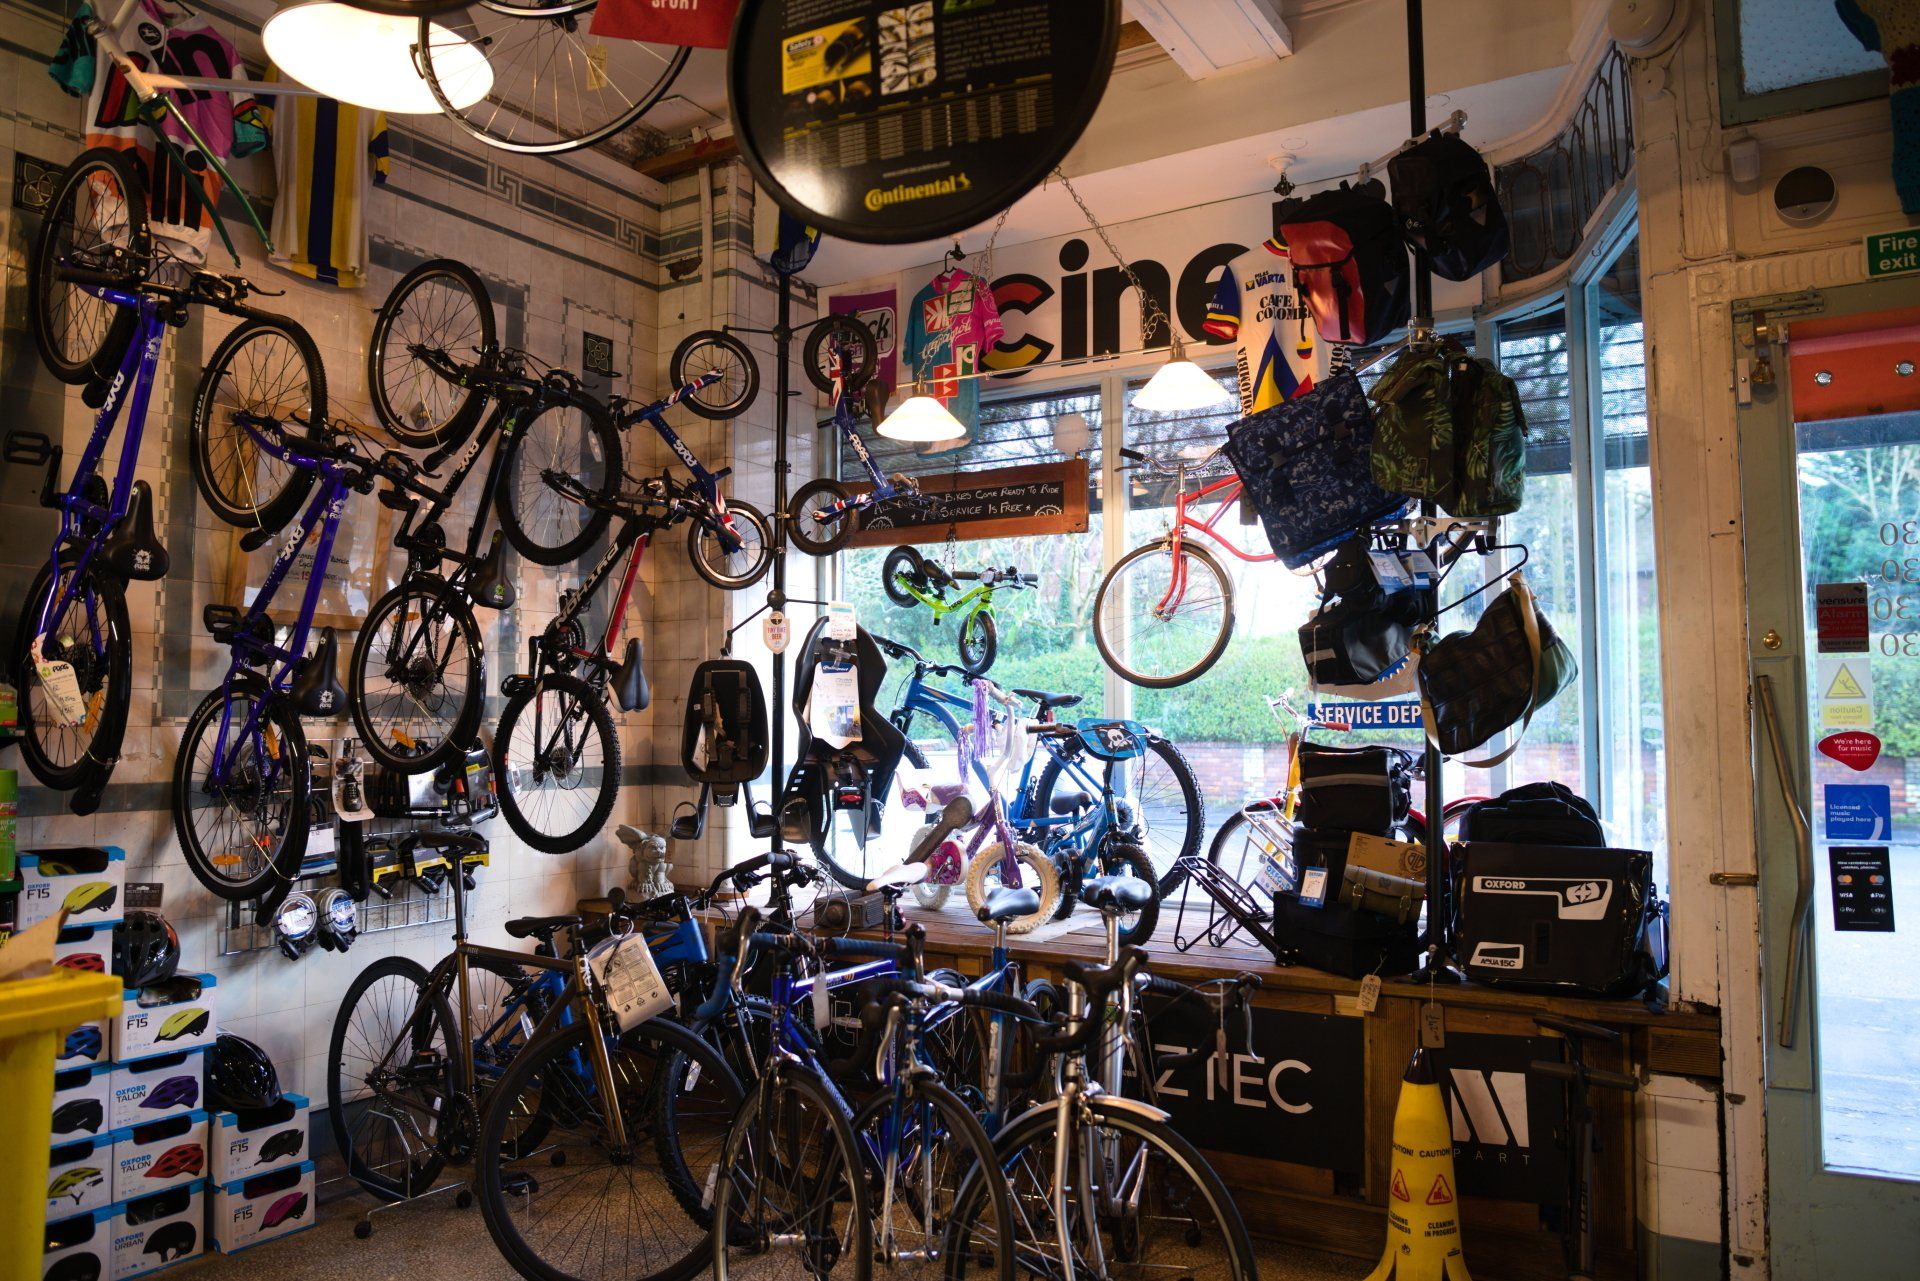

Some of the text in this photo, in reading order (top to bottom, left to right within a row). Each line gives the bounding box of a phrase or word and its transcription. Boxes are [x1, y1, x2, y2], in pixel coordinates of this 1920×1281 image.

[864, 175, 957, 211] Continental
[1879, 237, 1918, 253] Fire
[1879, 252, 1917, 270] exit
[1255, 272, 1286, 287] VARTA
[1259, 294, 1293, 308] CAFE
[673, 439, 698, 467] FROG
[555, 541, 619, 630] PYTHON
[1314, 704, 1422, 724] SERVICE DEP
[1484, 880, 1526, 890] OXFORD
[26, 888, 51, 900] F15
[126, 1019, 149, 1030] F15
[115, 1084, 147, 1097] OXFORD
[116, 1091, 147, 1103] TALON
[230, 1144, 249, 1155] F15
[1419, 1147, 1451, 1158] CAUTION
[120, 1154, 152, 1168] OXFORD
[121, 1161, 151, 1174] TALON
[233, 1211, 253, 1223] F15
[114, 1231, 145, 1245] OXFORD
[114, 1238, 145, 1251] URBAN
